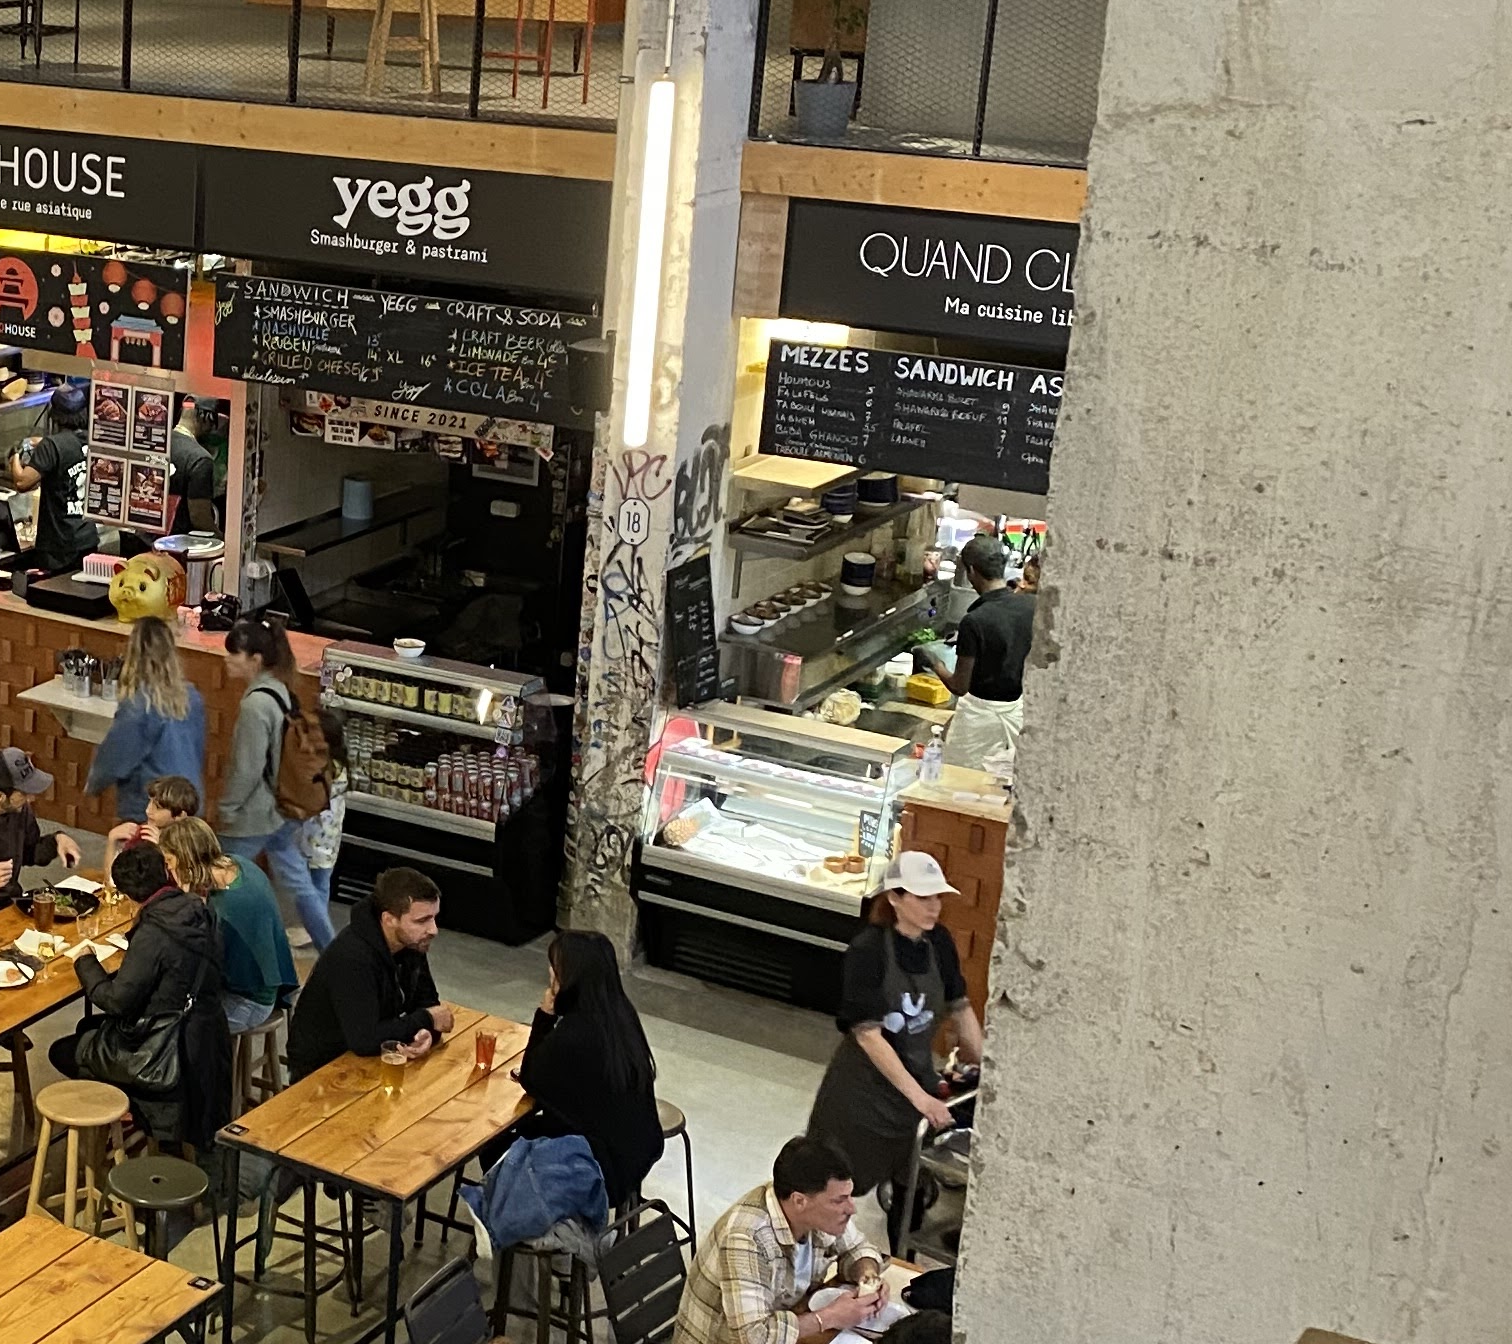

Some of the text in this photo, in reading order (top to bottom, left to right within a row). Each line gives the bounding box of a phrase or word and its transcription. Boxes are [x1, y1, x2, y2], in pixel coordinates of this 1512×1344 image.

[12, 199, 31, 213] rue
[36, 201, 93, 221] asiatique
[332, 175, 471, 240] yegg
[310, 228, 488, 264] Smashburger & pastrami
[859, 232, 1012, 285] QUAND
[244, 279, 563, 329] SANDWICH YEGG CRAFT & SODA
[944, 296, 970, 316] Ma
[977, 302, 1043, 324] cuisine
[261, 306, 357, 335] SMASHBURGER
[262, 321, 330, 341] NASHVILLE
[462, 329, 502, 346] CRAFT
[505, 334, 545, 354] BEER
[454, 360, 486, 377] ICE
[488, 366, 523, 385] TEA
[781, 343, 869, 374] MEZZES
[894, 357, 1015, 392] SANDWICH
[374, 405, 467, 430] SINCE 2021
[626, 511, 641, 533] 18
